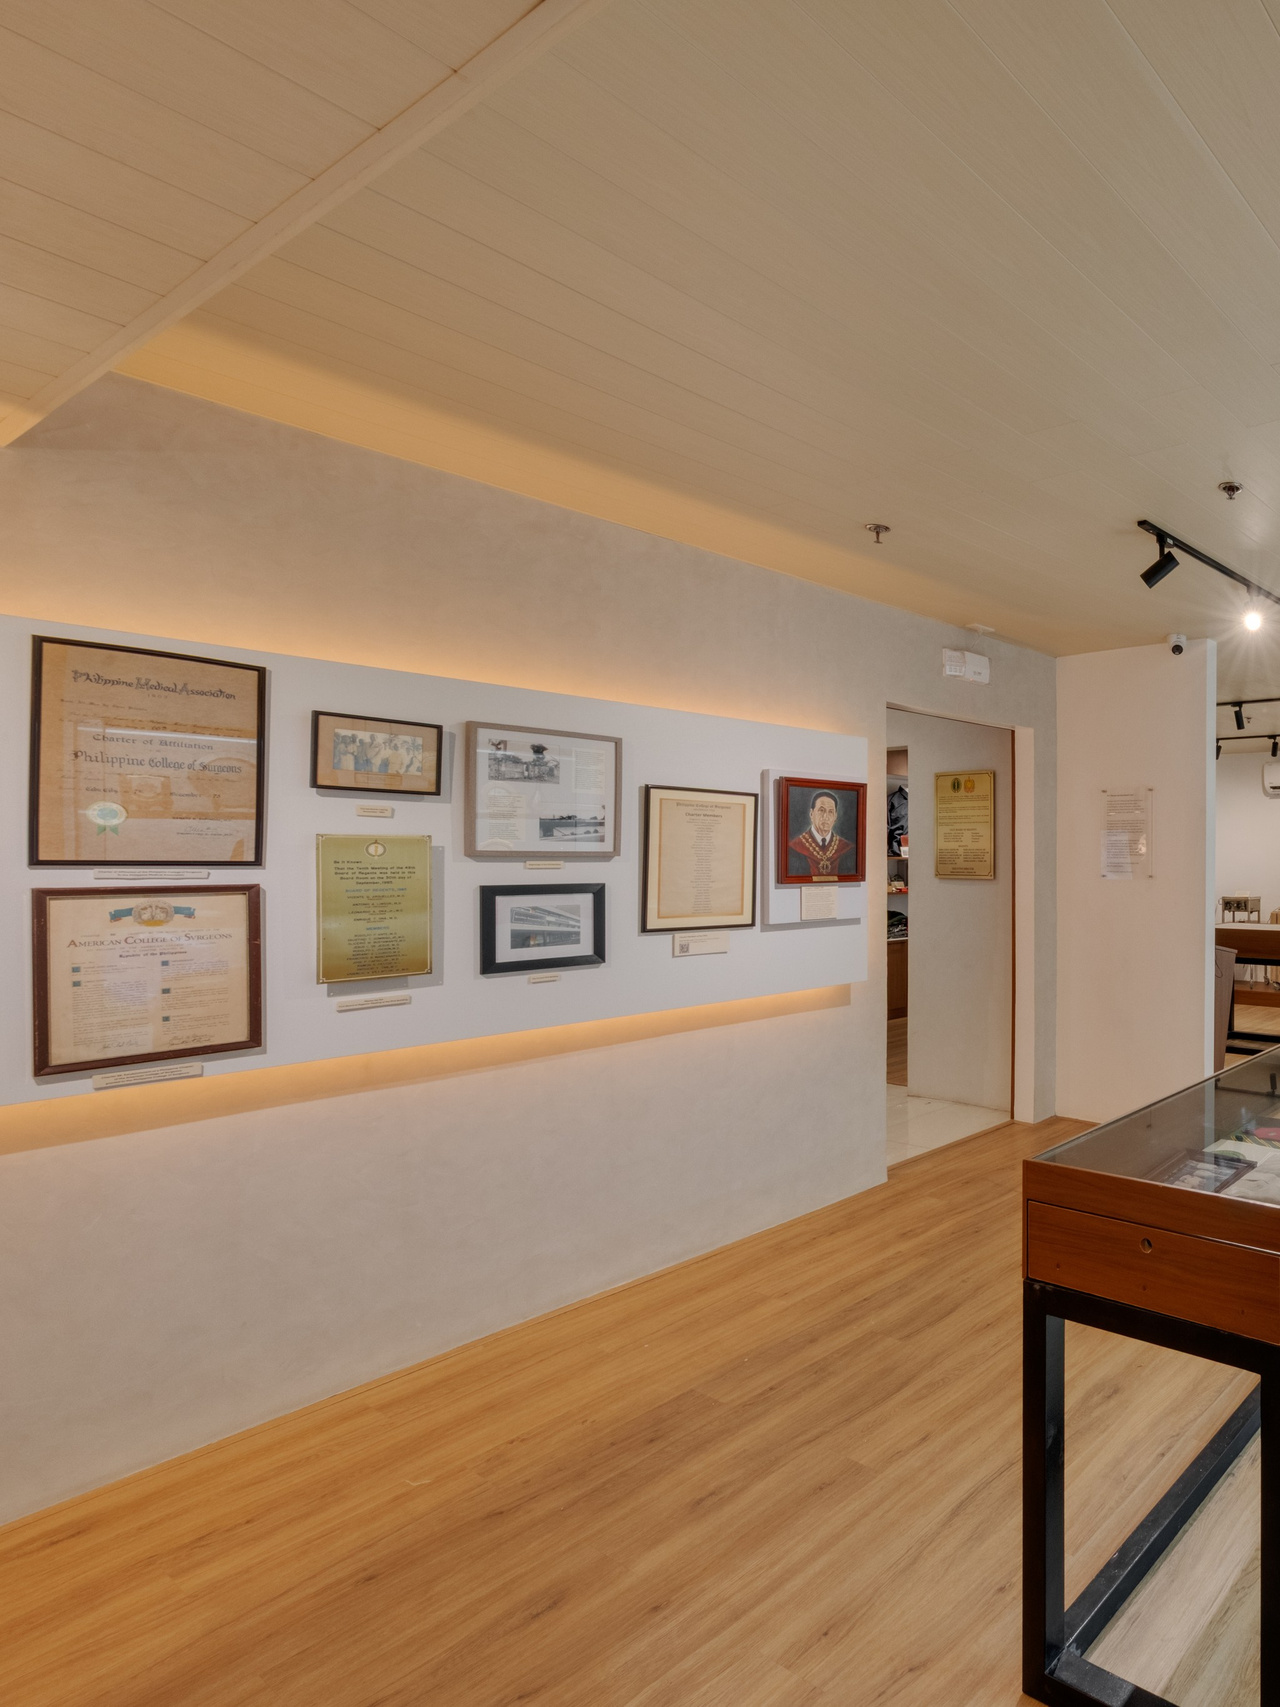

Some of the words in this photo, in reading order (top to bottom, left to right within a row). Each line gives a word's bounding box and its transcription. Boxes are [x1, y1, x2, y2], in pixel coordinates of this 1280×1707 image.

[72, 670, 133, 688] Philippine
[135, 676, 178, 693] Medical
[179, 682, 236, 700] Association
[92, 734, 136, 744] Charter
[159, 739, 214, 750] Affiliation
[72, 750, 145, 768] Philippine
[148, 757, 185, 771] College
[187, 759, 197, 771] of
[199, 763, 242, 775] Surgeons
[67, 939, 122, 948] AMERICAN
[124, 935, 168, 945] COLLEGE
